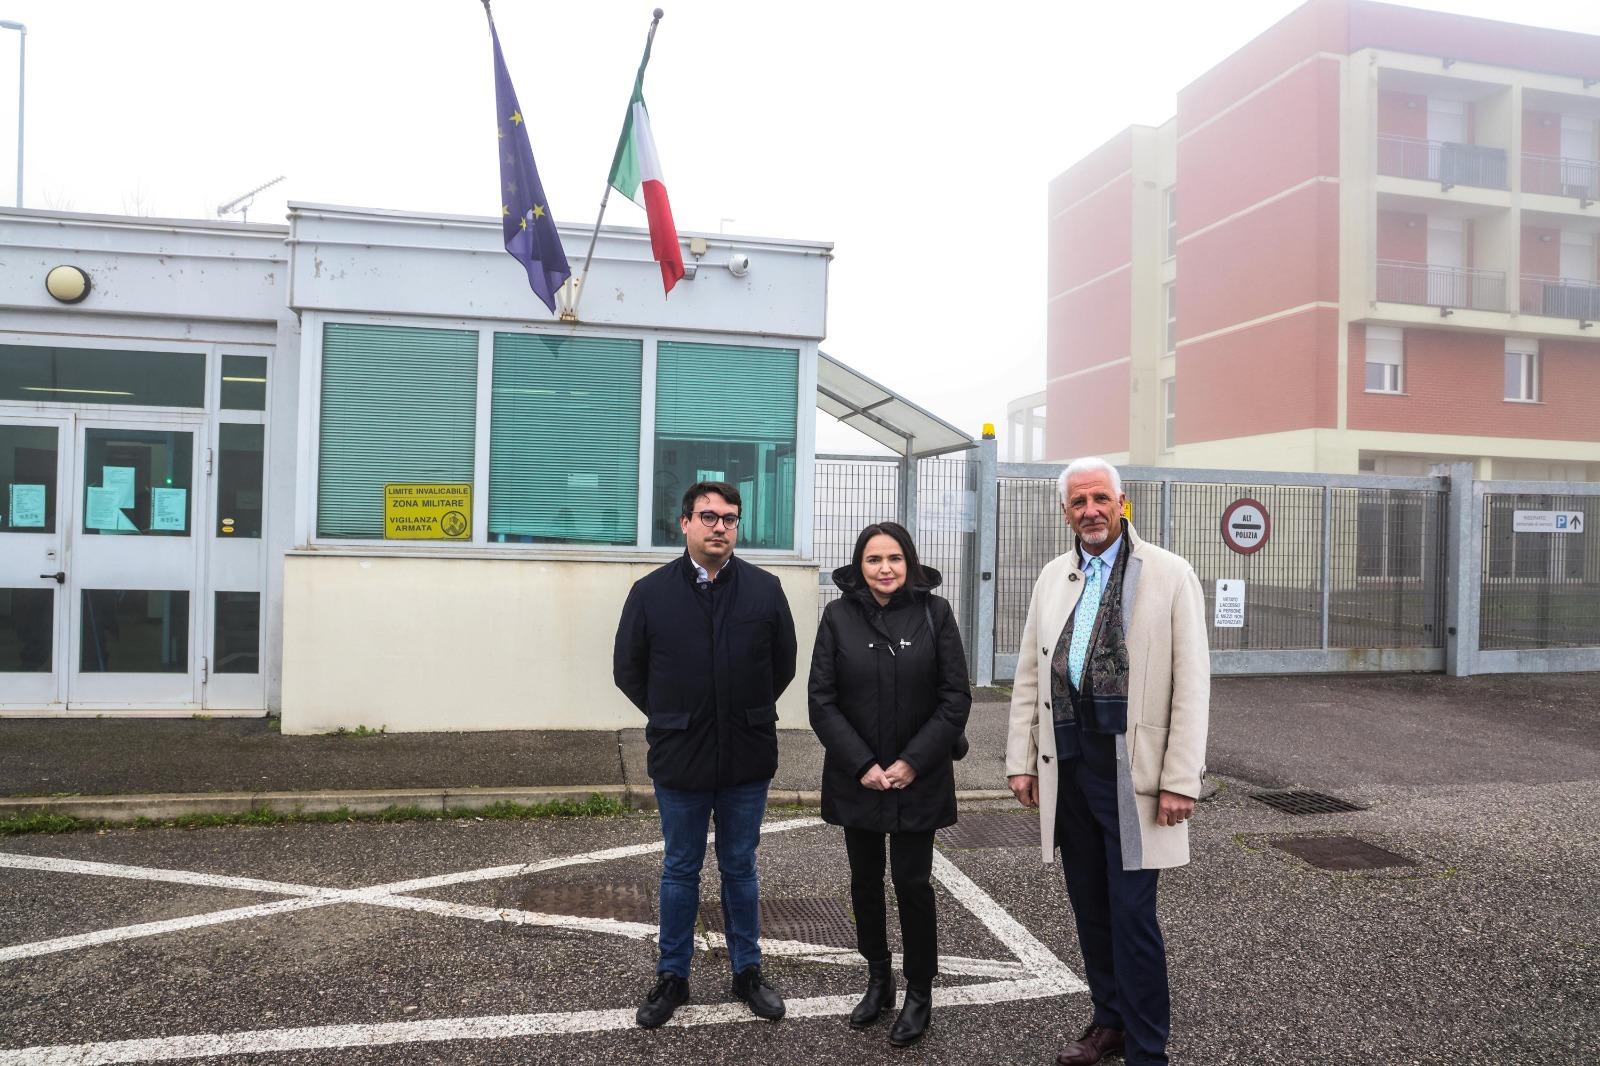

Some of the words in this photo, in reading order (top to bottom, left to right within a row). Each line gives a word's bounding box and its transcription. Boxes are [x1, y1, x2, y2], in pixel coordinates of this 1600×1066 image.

[416, 487, 469, 495] INVALICABILE
[392, 499, 419, 508] ZONA
[422, 499, 464, 507] MILITARE
[389, 516, 438, 524] VIGILANZA
[1242, 514, 1252, 522] ALT
[1235, 531, 1258, 539] POLIZIA
